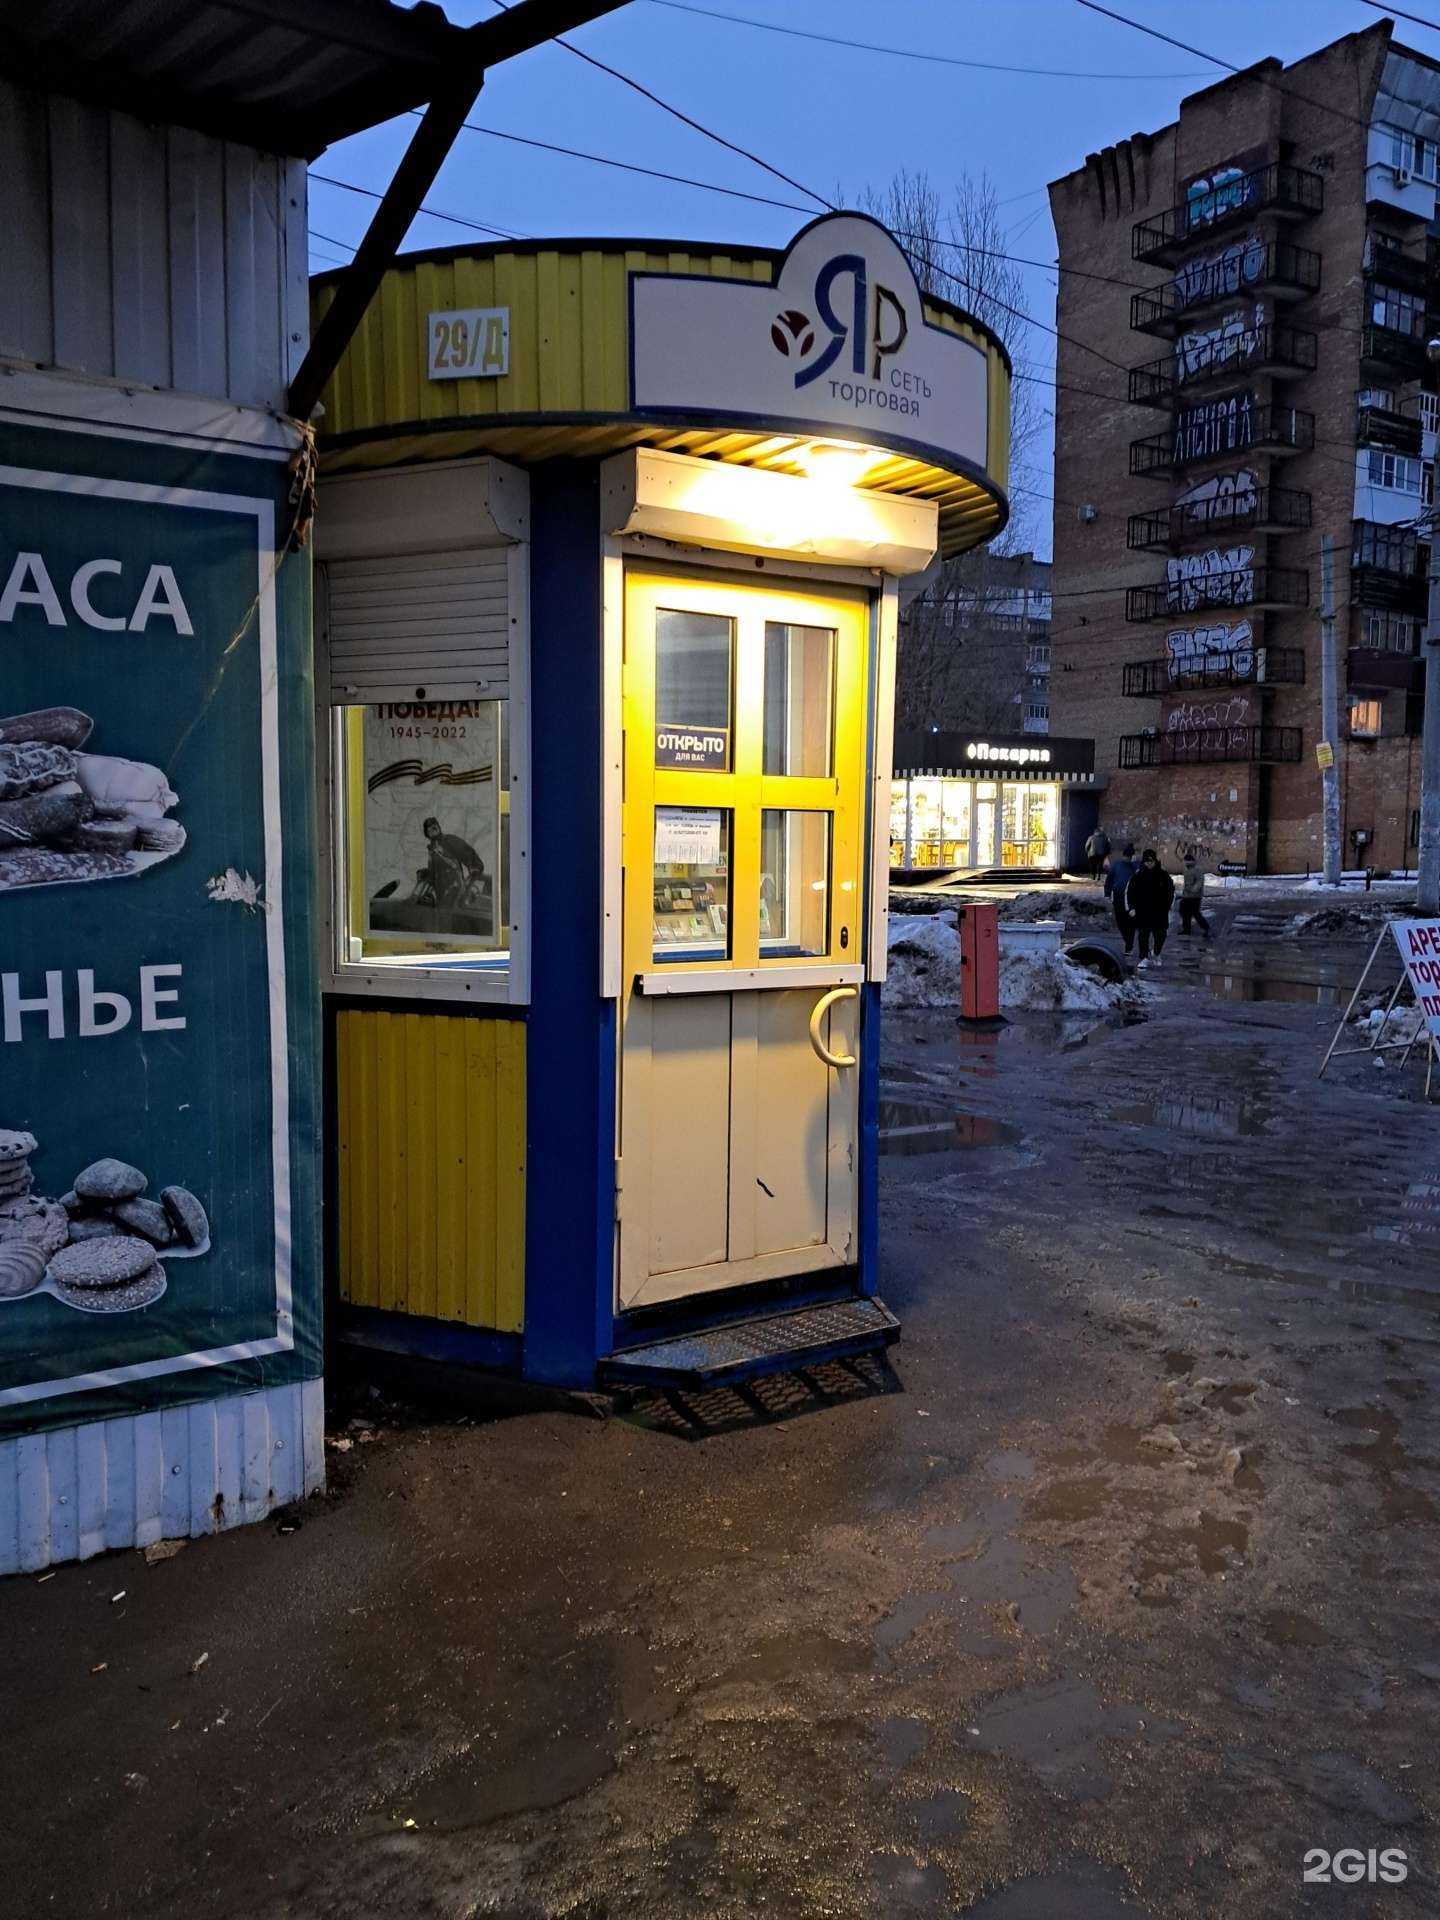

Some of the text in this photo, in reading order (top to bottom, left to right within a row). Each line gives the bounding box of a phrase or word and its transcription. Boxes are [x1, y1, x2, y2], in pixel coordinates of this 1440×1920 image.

[434, 316, 504, 373] 29/Д
[828, 380, 920, 417] торговая
[890, 369, 932, 398] СЕТЬ
[0, 551, 194, 635] АСА
[390, 727, 466, 738] 1945-2022
[657, 734, 724, 753] ОТКРЫТО
[675, 752, 705, 762] ДЛЯ ВАС
[1407, 926, 1440, 957] АРЕ
[1, 963, 187, 1042] НЬЕ
